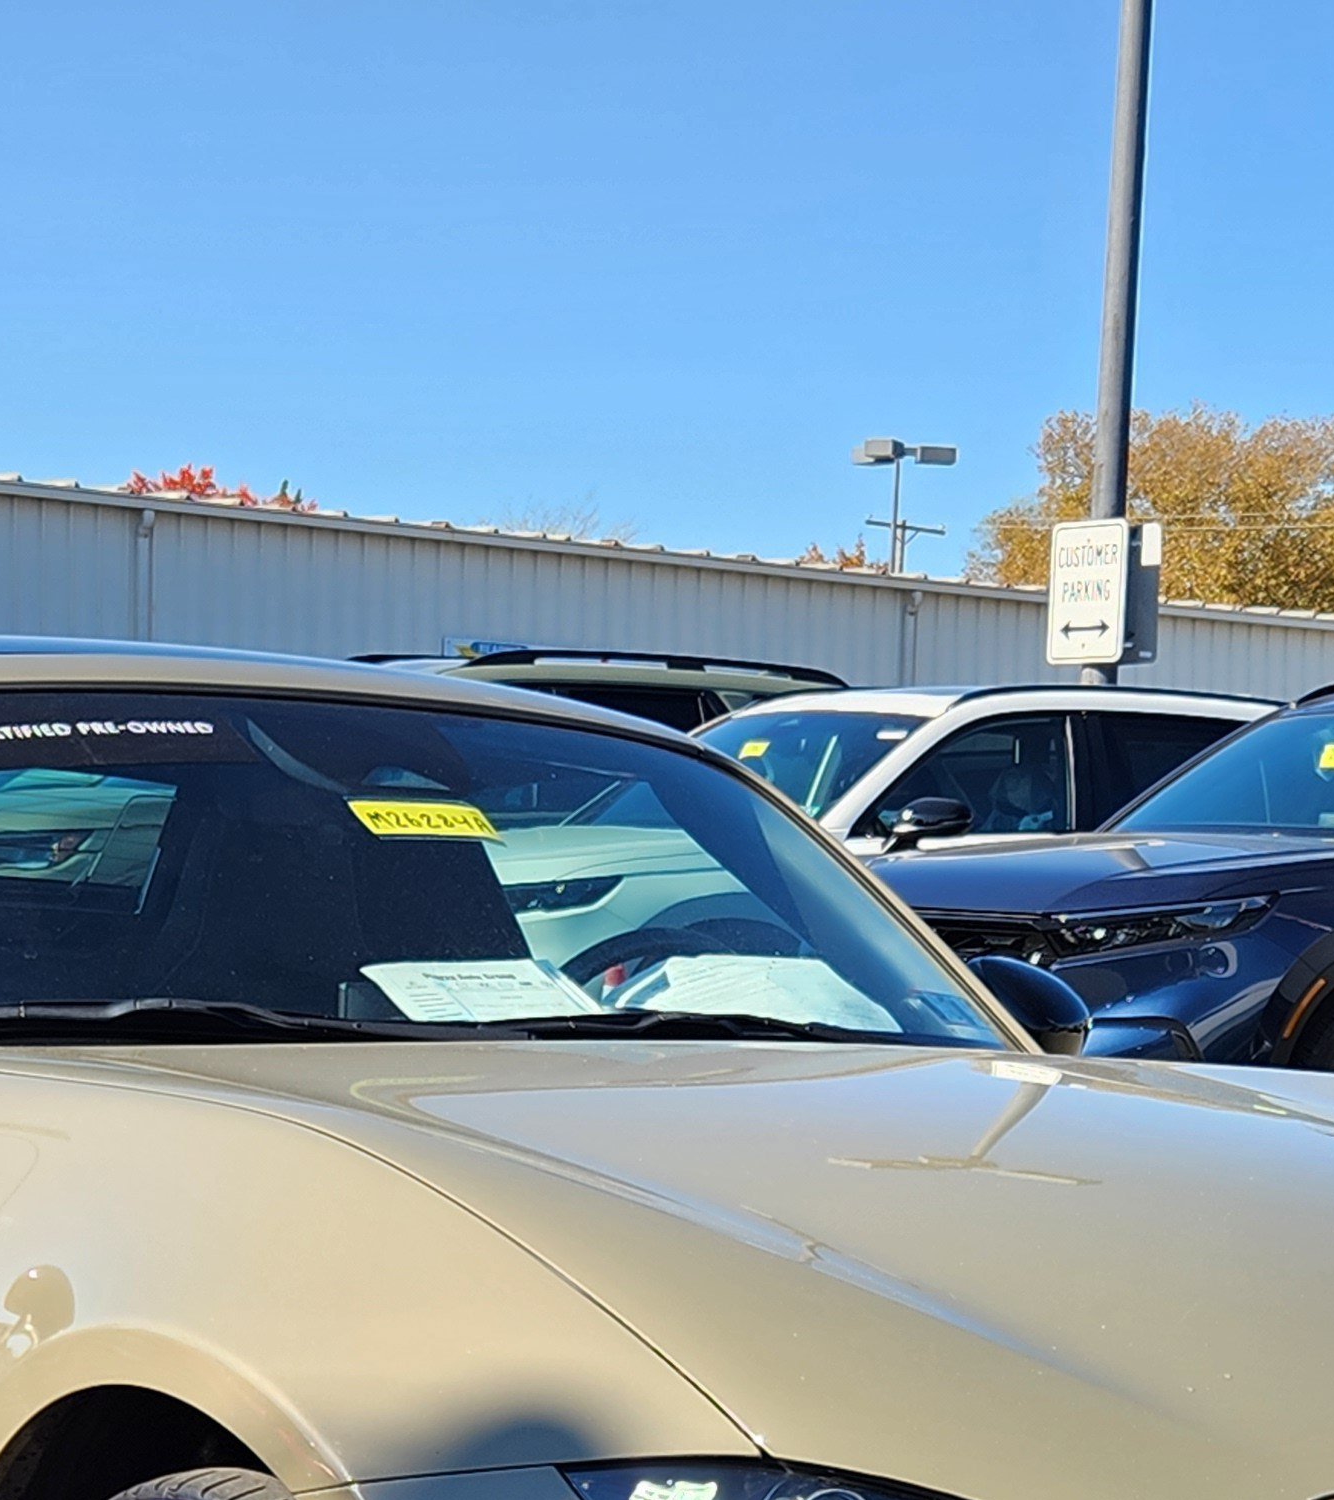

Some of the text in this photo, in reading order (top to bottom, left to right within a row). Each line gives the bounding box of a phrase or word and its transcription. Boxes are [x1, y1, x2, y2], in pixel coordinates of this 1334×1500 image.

[1058, 543, 1117, 568] CUSTOMER
[1061, 579, 1111, 602] PARKING
[75, 720, 214, 735] PRE-OWNED
